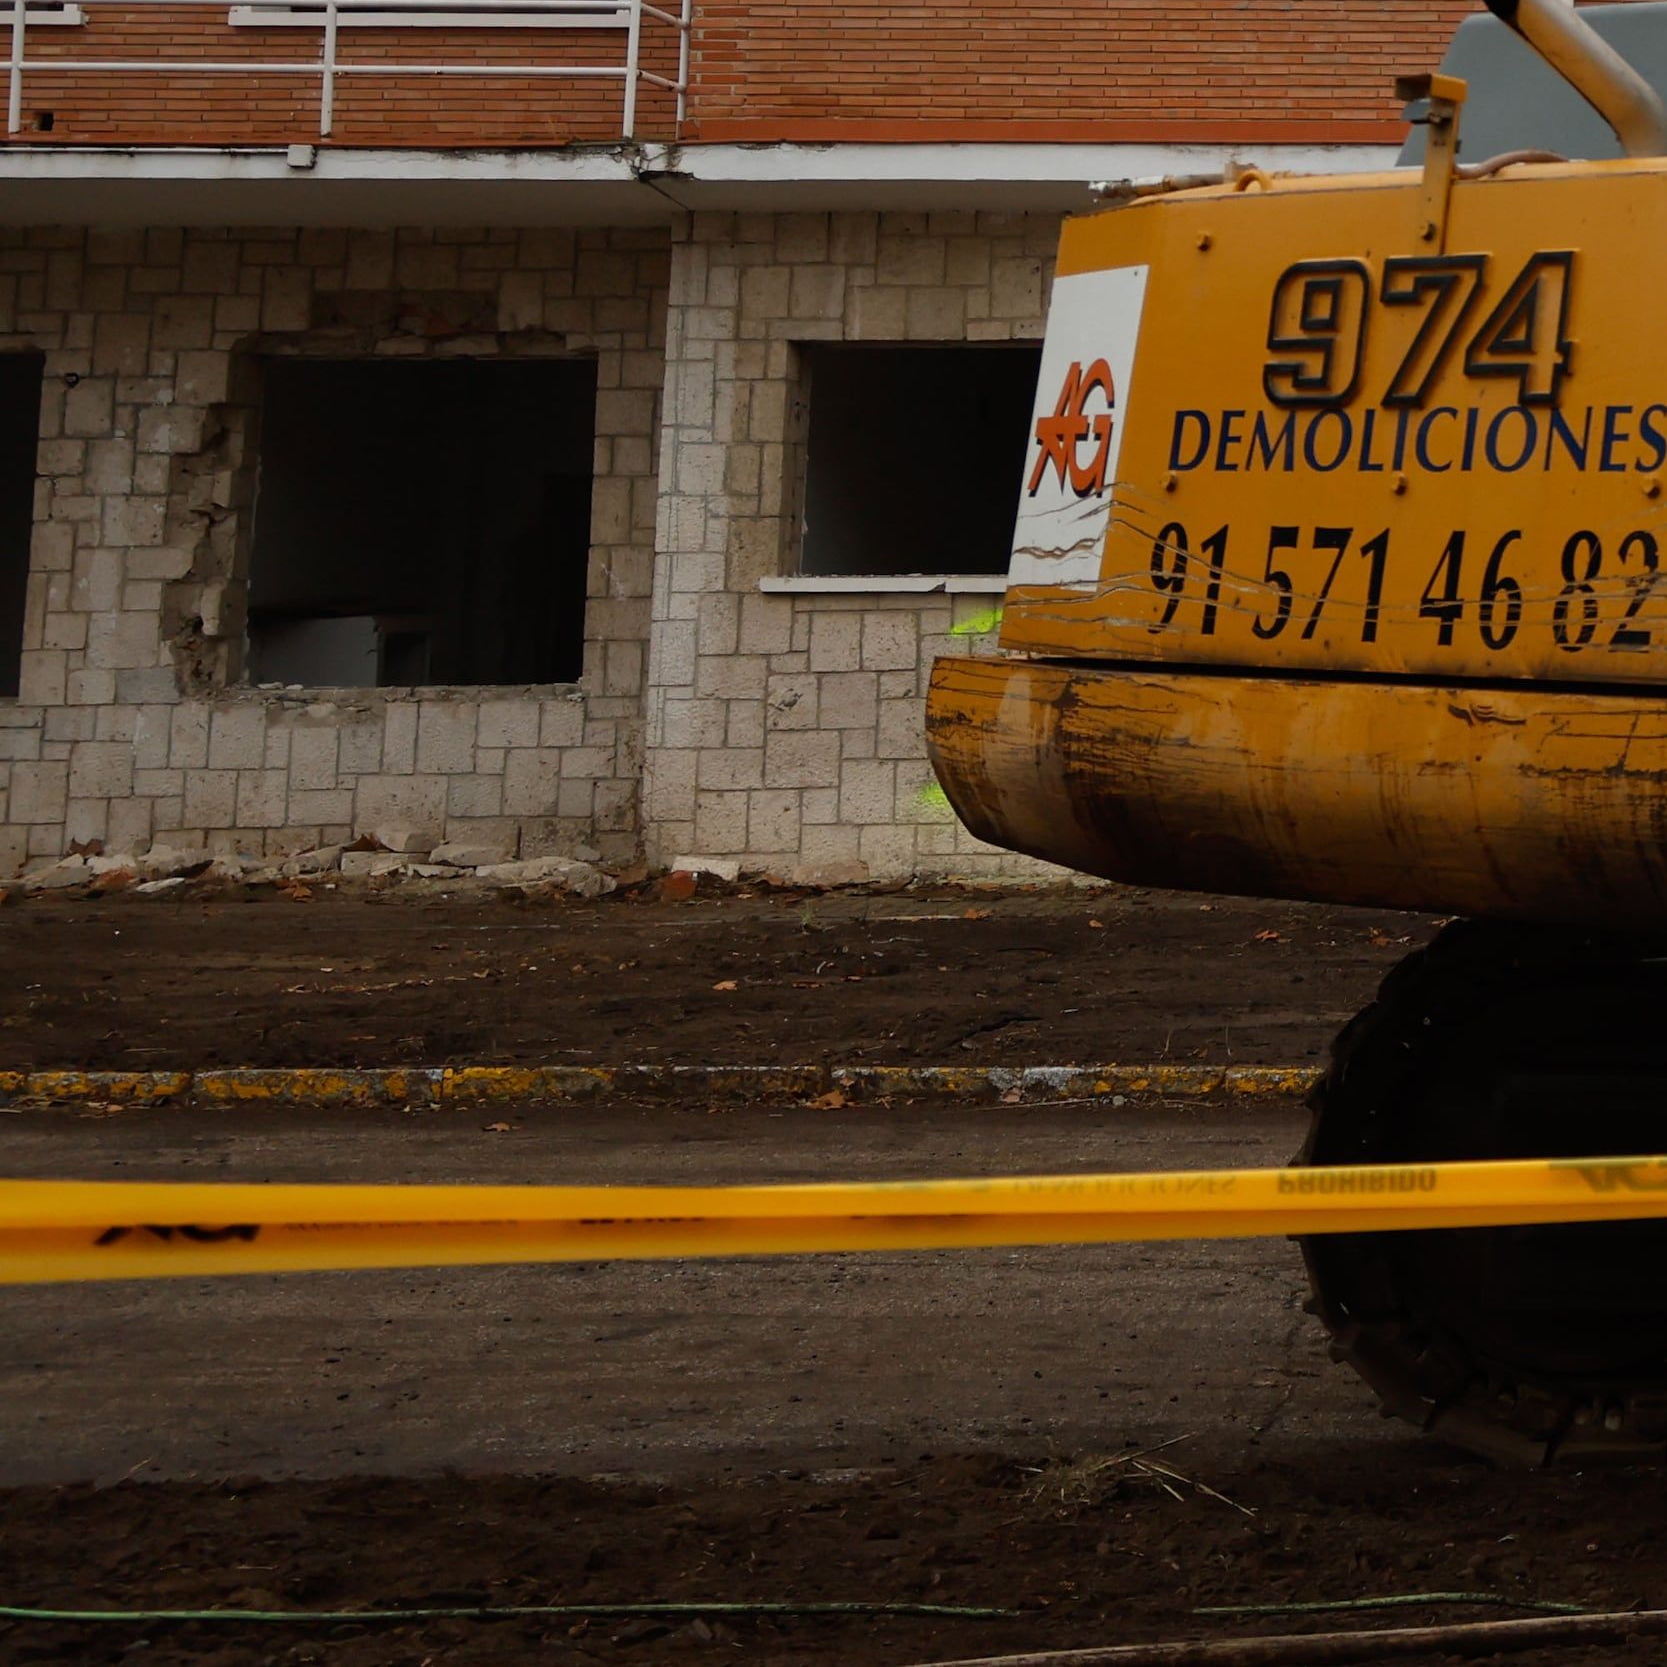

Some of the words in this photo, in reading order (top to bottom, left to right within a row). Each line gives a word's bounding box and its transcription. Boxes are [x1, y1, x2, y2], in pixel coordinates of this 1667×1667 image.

[1263, 249, 1579, 409] 974
[1027, 357, 1116, 499] AG
[1147, 521, 1230, 636] 91
[1252, 525, 1392, 643] 571
[1418, 529, 1523, 651] 46
[1551, 529, 1660, 653] 82
